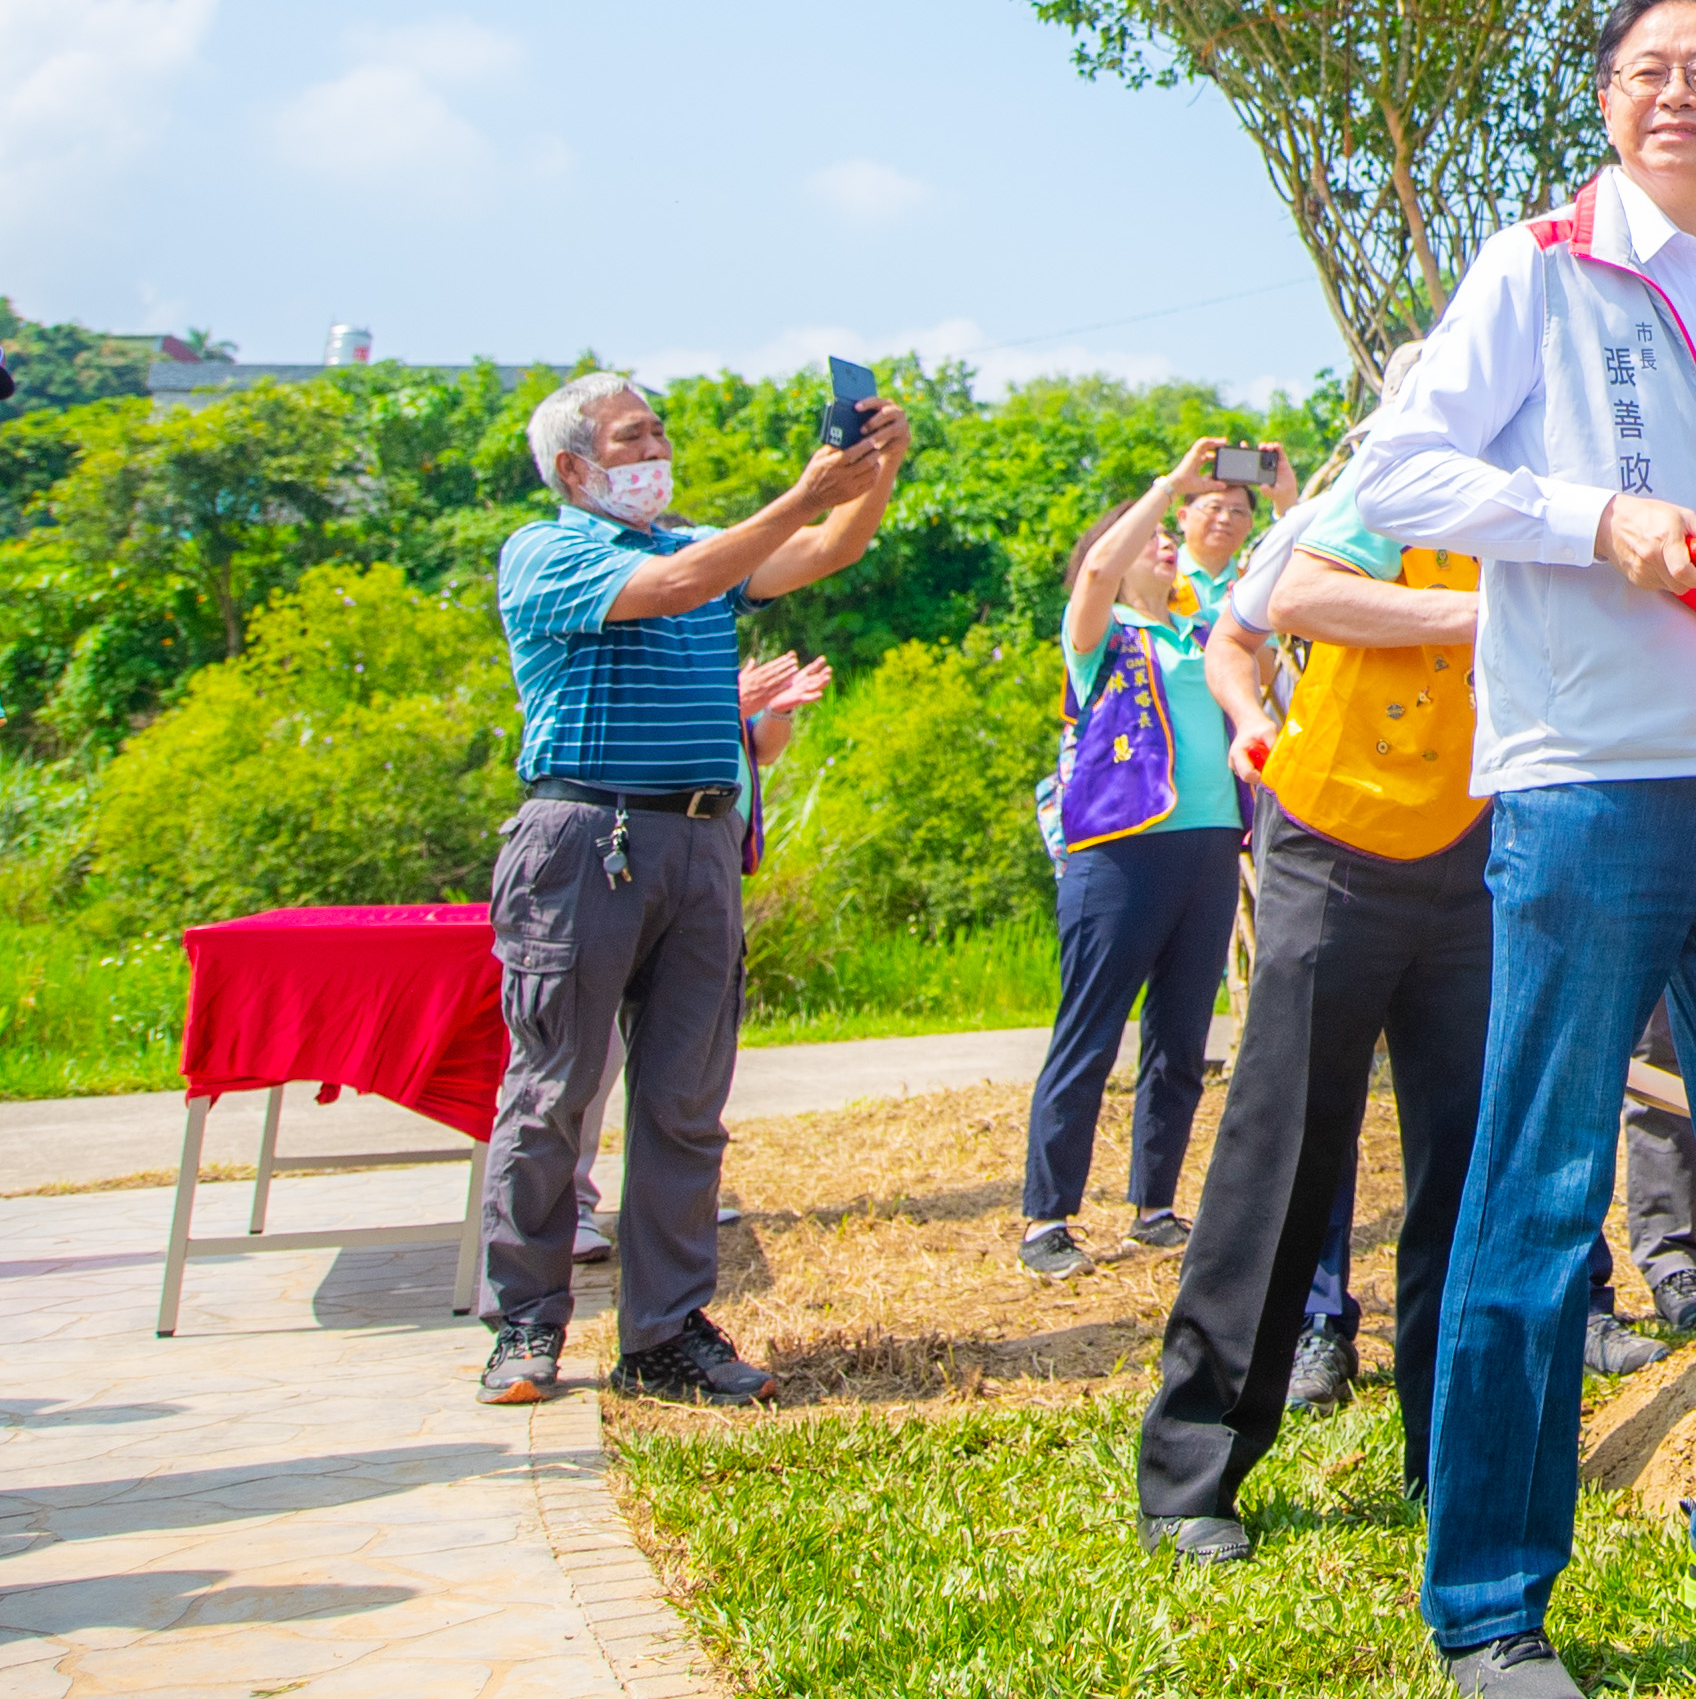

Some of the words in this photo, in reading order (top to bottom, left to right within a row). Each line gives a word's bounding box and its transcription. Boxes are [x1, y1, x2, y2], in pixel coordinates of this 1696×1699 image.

[1635, 320, 1658, 371] 市長
[1603, 346, 1654, 495] 張善政
